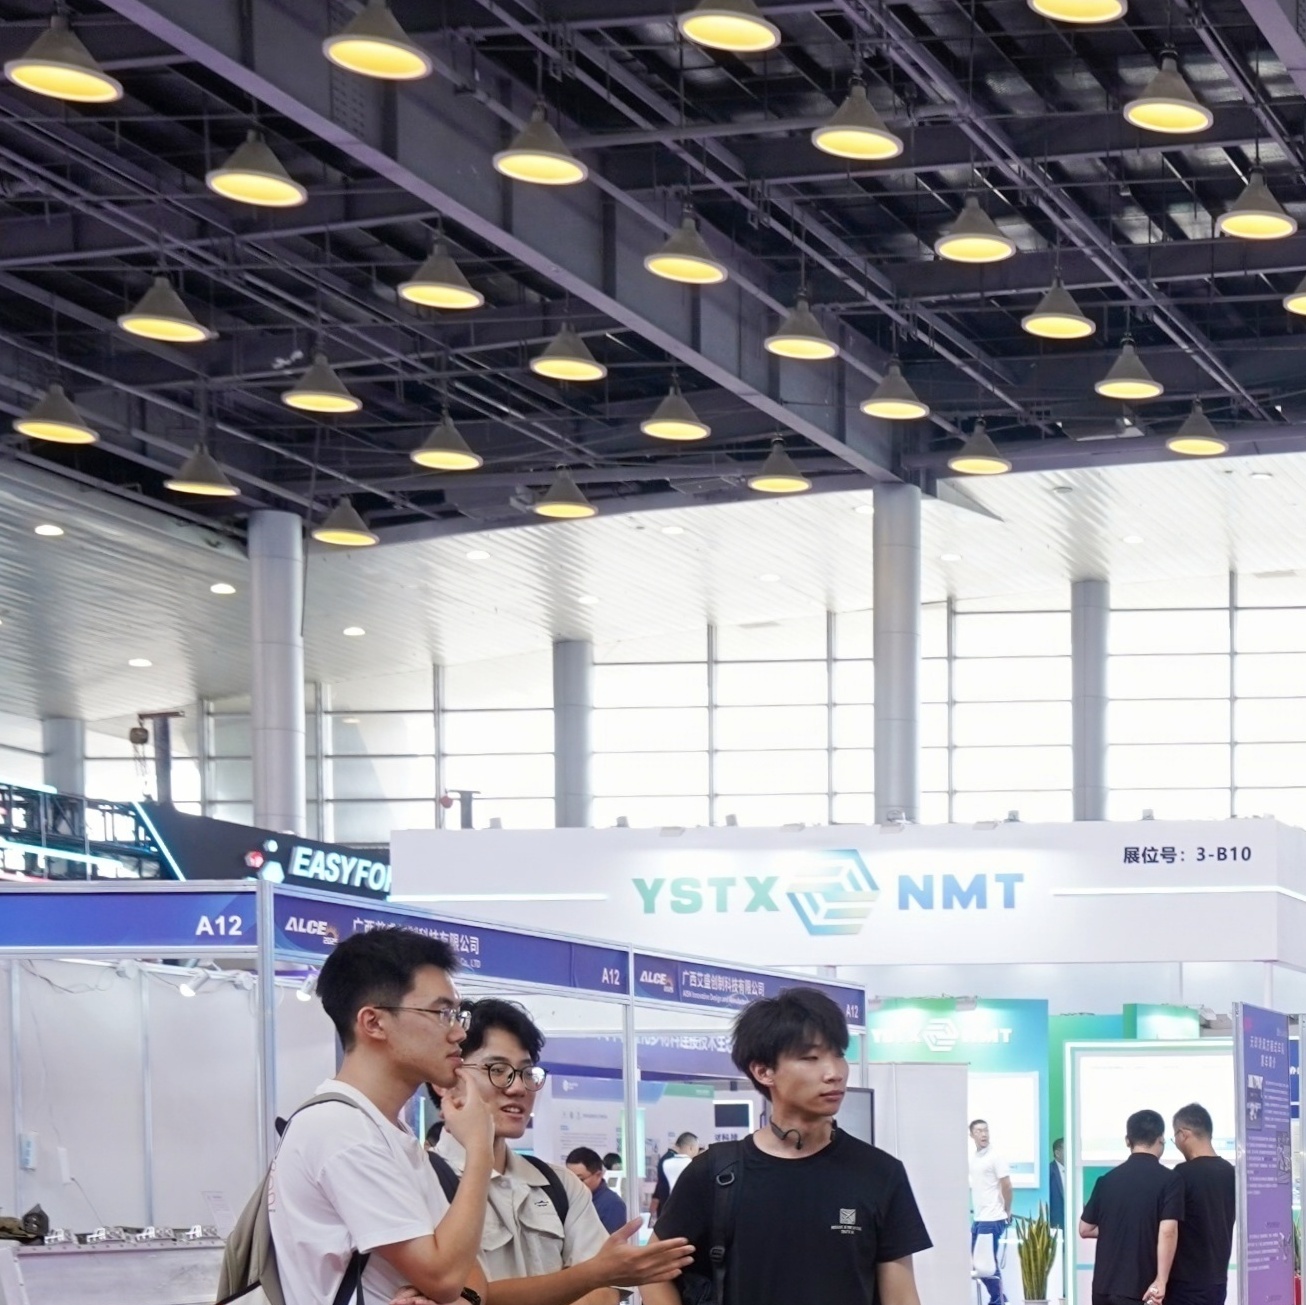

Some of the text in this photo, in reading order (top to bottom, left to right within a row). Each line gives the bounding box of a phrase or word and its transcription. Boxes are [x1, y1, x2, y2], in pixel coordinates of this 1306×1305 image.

[632, 872, 1025, 914] YSTX NMT
[195, 915, 242, 936] A12
[285, 917, 328, 936] ALCE
[601, 967, 620, 986] A12
[846, 1004, 859, 1019] A12
